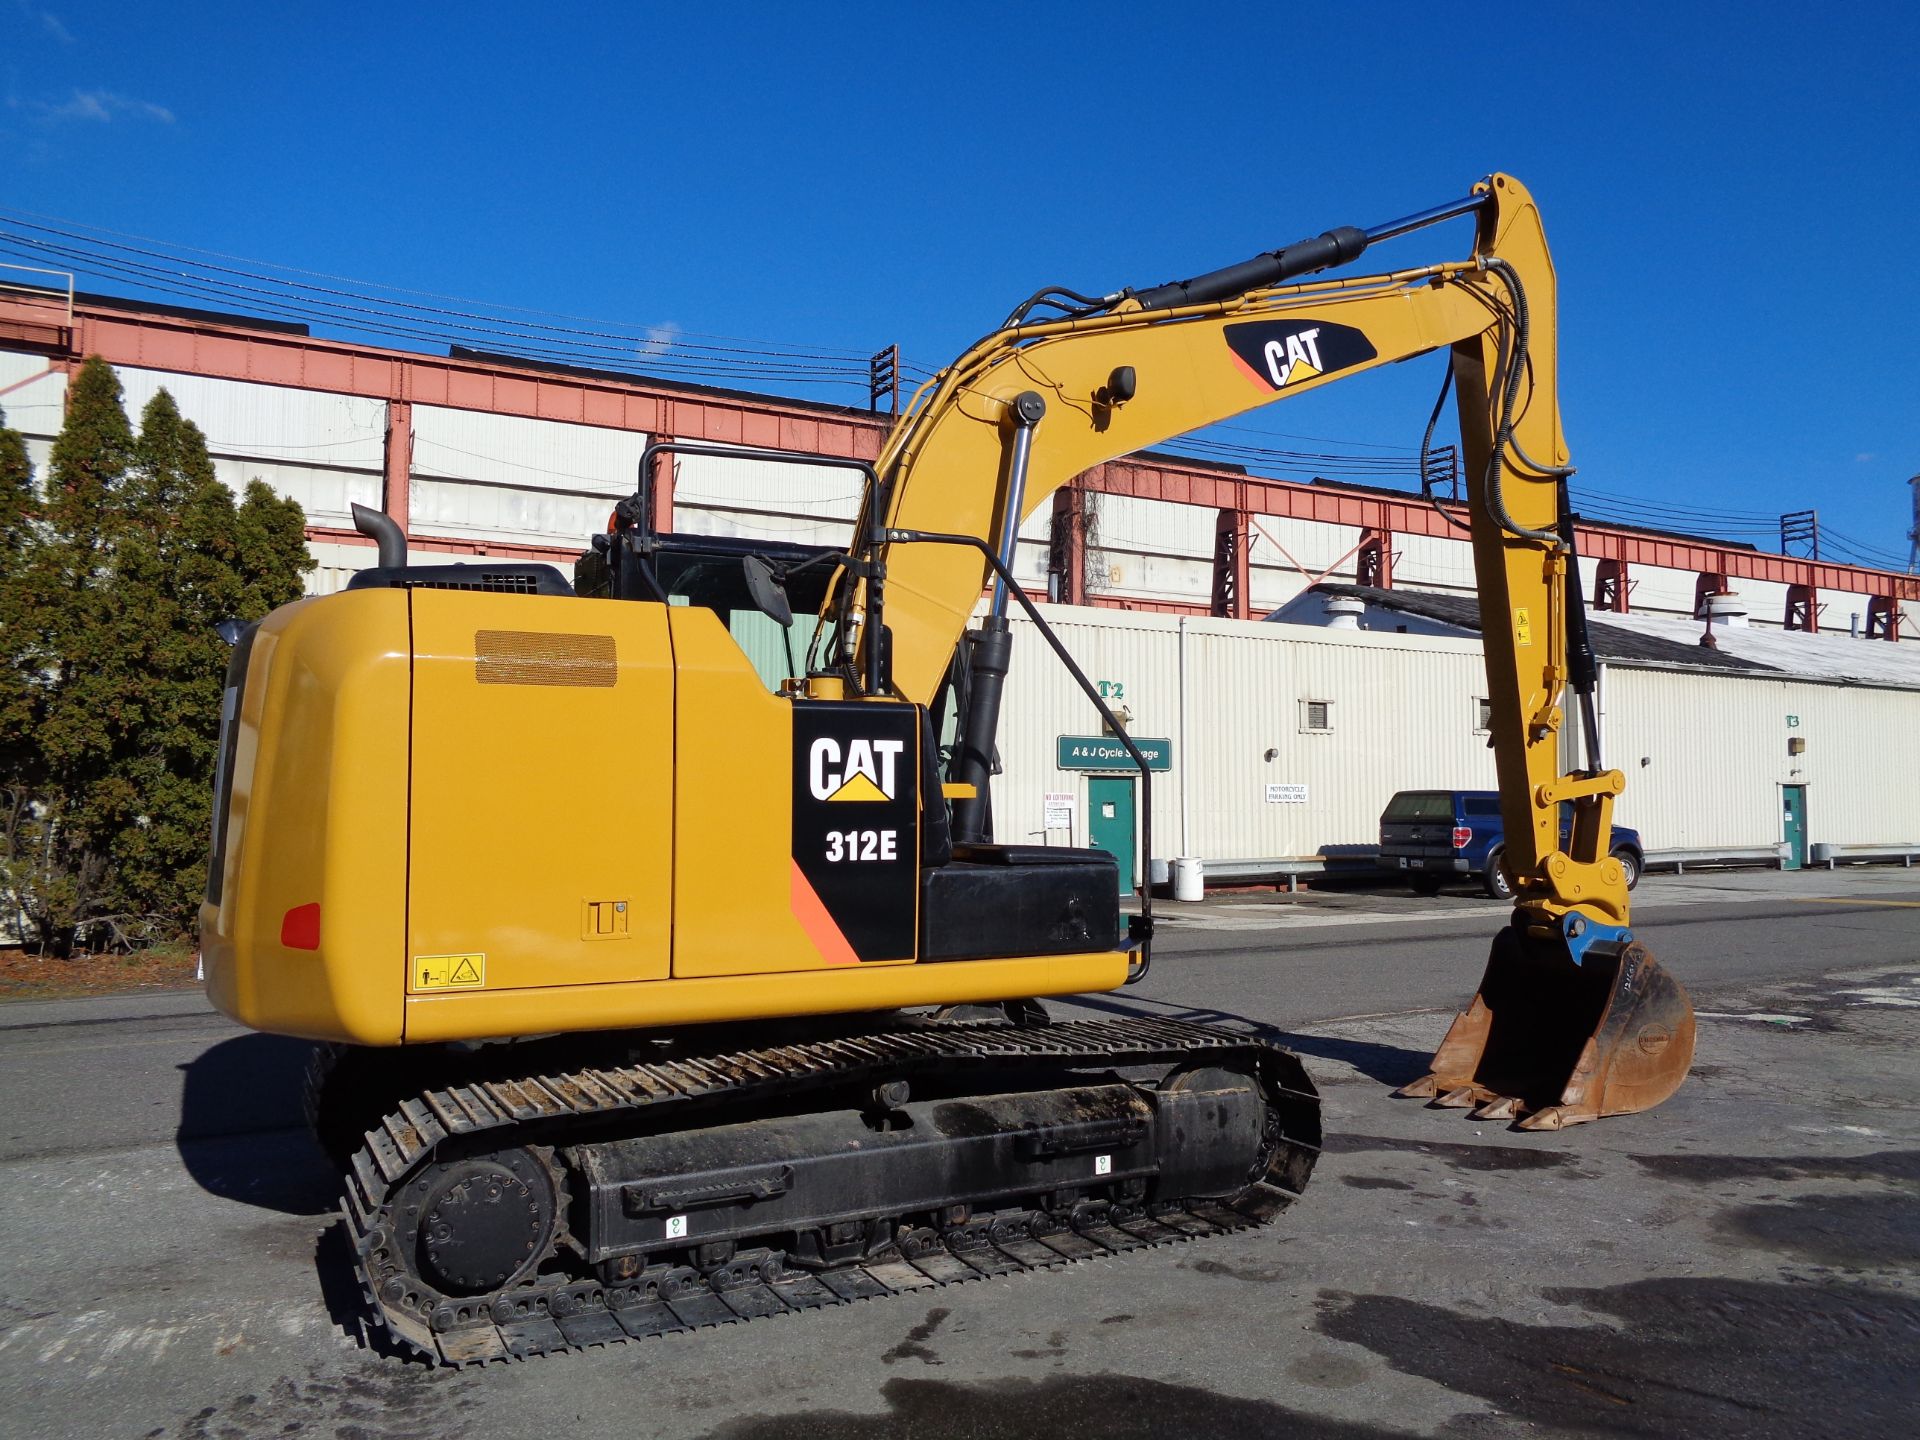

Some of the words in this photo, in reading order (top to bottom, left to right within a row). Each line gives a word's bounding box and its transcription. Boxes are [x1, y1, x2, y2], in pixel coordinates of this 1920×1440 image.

[1264, 328, 1323, 386] CAT
[1098, 680, 1124, 699] T2
[1785, 715, 1799, 728] T3
[1072, 747, 1080, 756] A
[1081, 747, 1089, 757] &
[1090, 747, 1097, 756] J
[1098, 747, 1123, 759] Cycle
[810, 737, 904, 801] CAT
[825, 830, 897, 862] 312E
